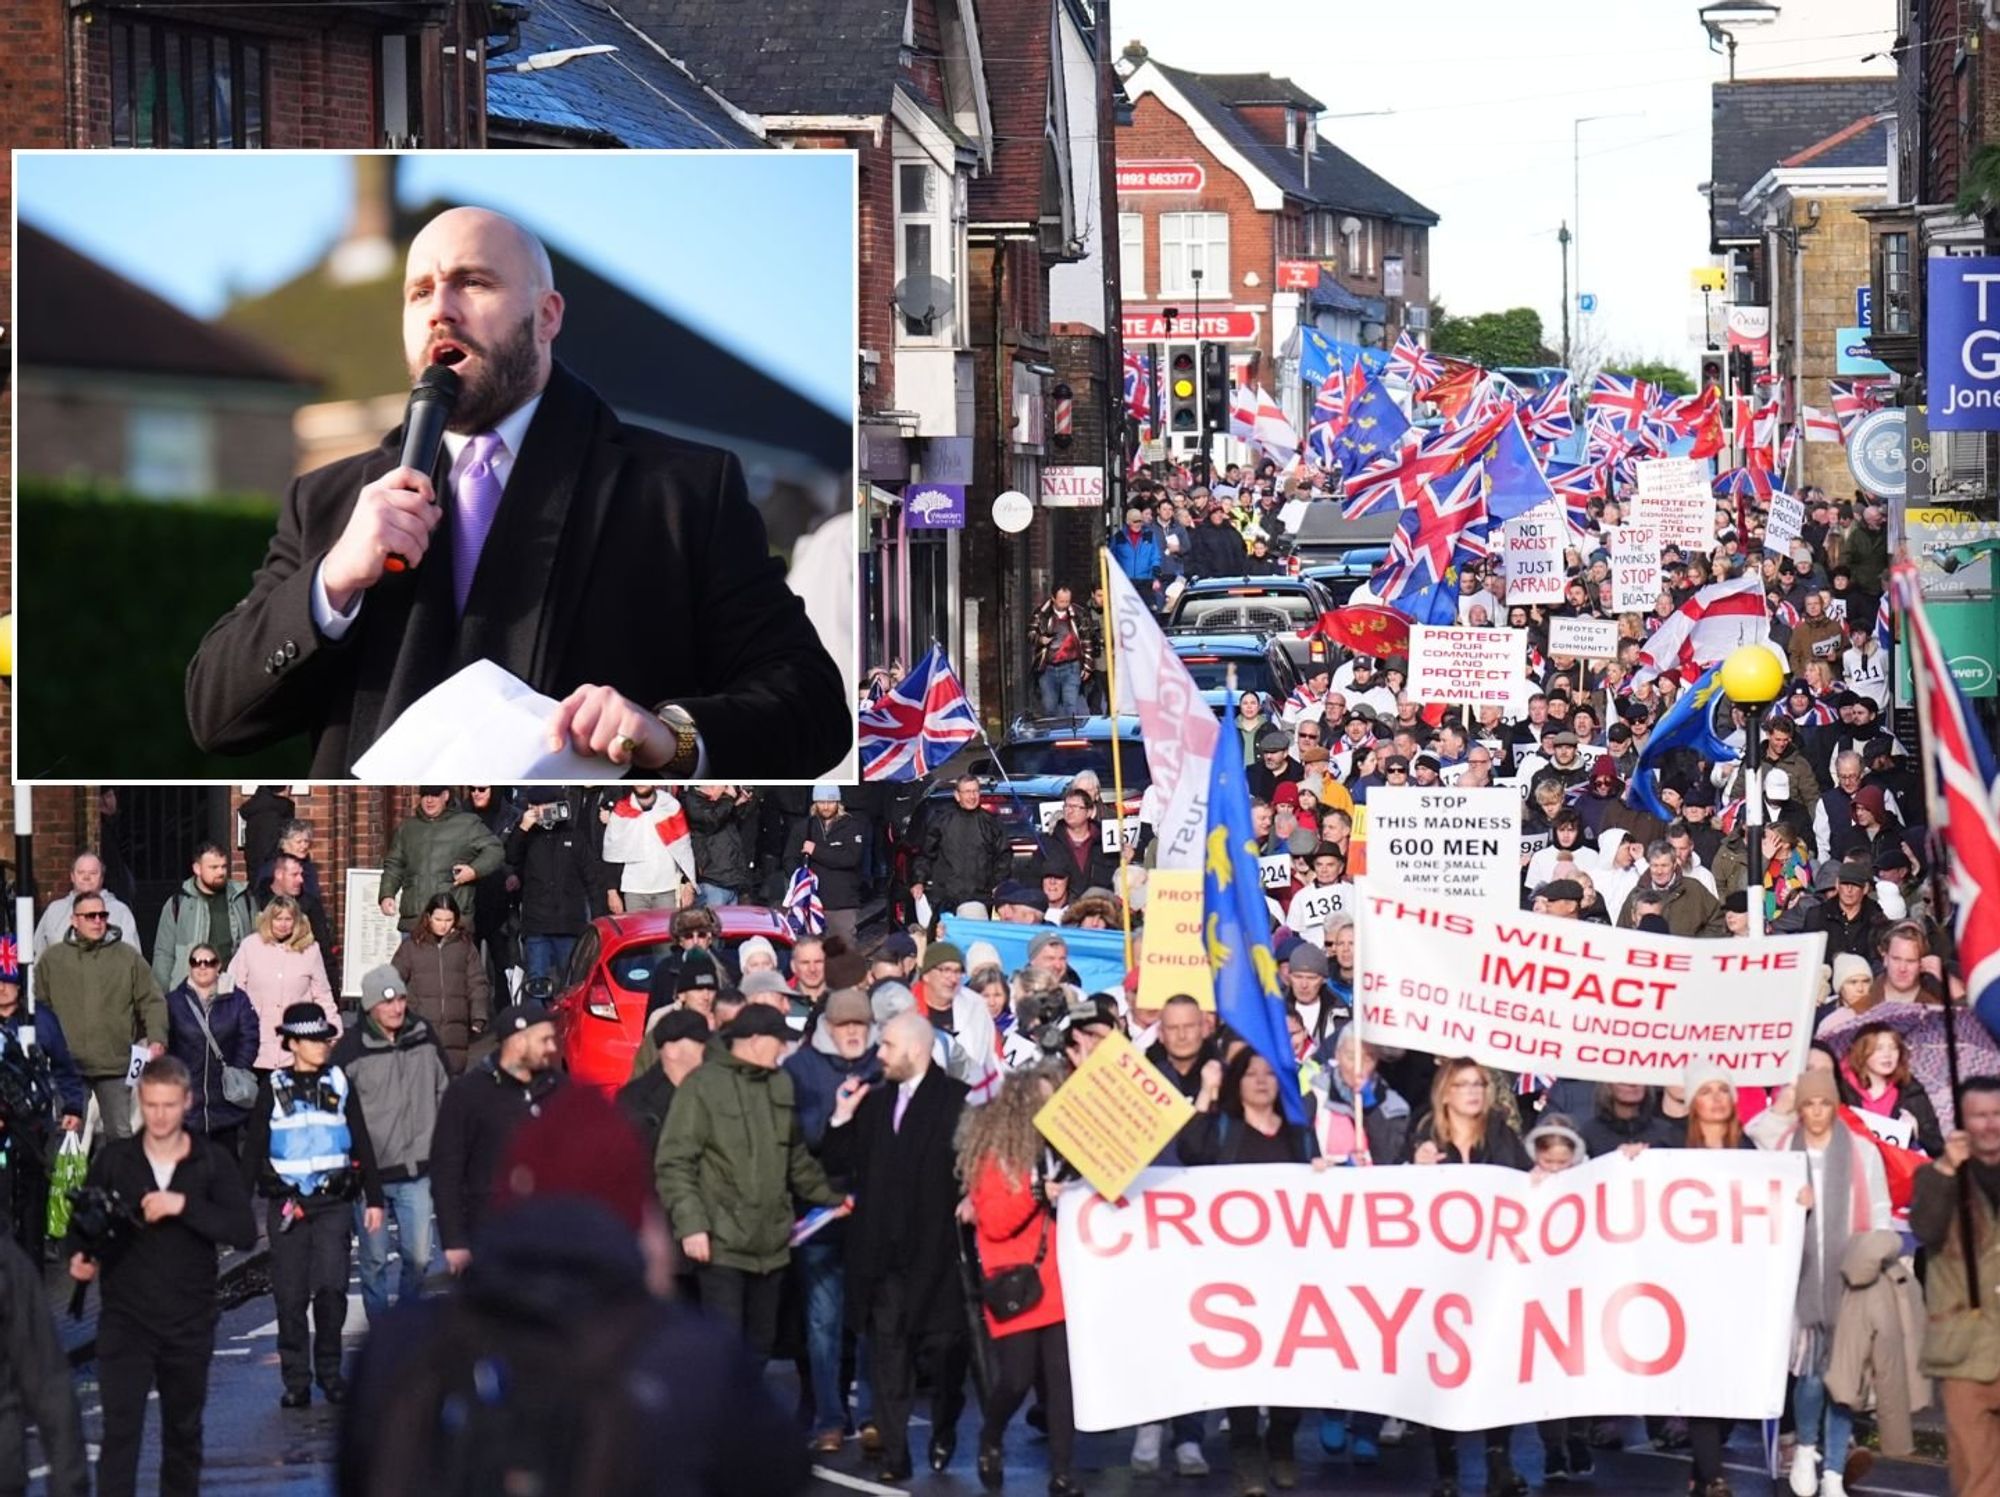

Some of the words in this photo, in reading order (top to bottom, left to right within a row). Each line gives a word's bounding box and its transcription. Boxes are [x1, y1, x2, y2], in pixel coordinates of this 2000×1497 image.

[1942, 384, 2000, 414] Jone
[1041, 479, 1102, 495] NAILS
[1519, 524, 1546, 537] NOT
[1618, 529, 1654, 544] STOP
[1768, 523, 1793, 540] DEPO
[1510, 536, 1557, 551] RACIST
[1613, 553, 1657, 565] MADNESS
[1516, 560, 1554, 575] JUST
[1620, 569, 1657, 585] STOP
[1508, 577, 1561, 593] AFRAID
[1621, 592, 1658, 606] BOATS
[1424, 630, 1513, 642] PROTECT
[1560, 625, 1608, 634] PROTECT
[1452, 642, 1483, 650] OUR
[1422, 650, 1511, 660] COMMUNITY
[1452, 660, 1484, 668] AND
[1422, 668, 1513, 680] PROTECT
[1854, 665, 1880, 682] 211
[1420, 688, 1510, 700] FAMILIES
[1420, 796, 1468, 808] STOP
[1376, 817, 1418, 829] THIS
[1424, 817, 1512, 829] MADNESS
[1389, 838, 1434, 855] 600
[1443, 839, 1499, 856] MEN
[1395, 860, 1410, 869] IN
[1413, 860, 1440, 869] ONE
[1444, 860, 1487, 870] SMALL
[1402, 874, 1440, 883] ARMY
[1443, 874, 1480, 884] CAMP
[1157, 890, 1204, 902] PROT
[1444, 887, 1487, 897] SMALL
[1306, 894, 1343, 919] 138
[1175, 923, 1202, 933] OU
[1368, 896, 1474, 936] THIS
[1496, 924, 1606, 962] WILL
[1627, 949, 1692, 971] BE
[1712, 951, 1799, 972] THE
[1480, 953, 1677, 1011] IMPACT
[1362, 972, 1388, 992] OF
[1399, 979, 1449, 1005] 600
[1458, 991, 1562, 1029] ILLEGAL
[1572, 1013, 1793, 1042] UNDOCUMENTED
[1362, 1003, 1430, 1032] MEN
[1441, 1020, 1475, 1043] IN
[1489, 1030, 1563, 1060] OUR
[1576, 1042, 1790, 1070] COMMNITY
[1119, 1053, 1172, 1107] STOP
[1077, 1178, 1782, 1264] CROWBOROUGH
[1189, 1282, 1474, 1389] SAYS
[1518, 1281, 1686, 1384] NO
